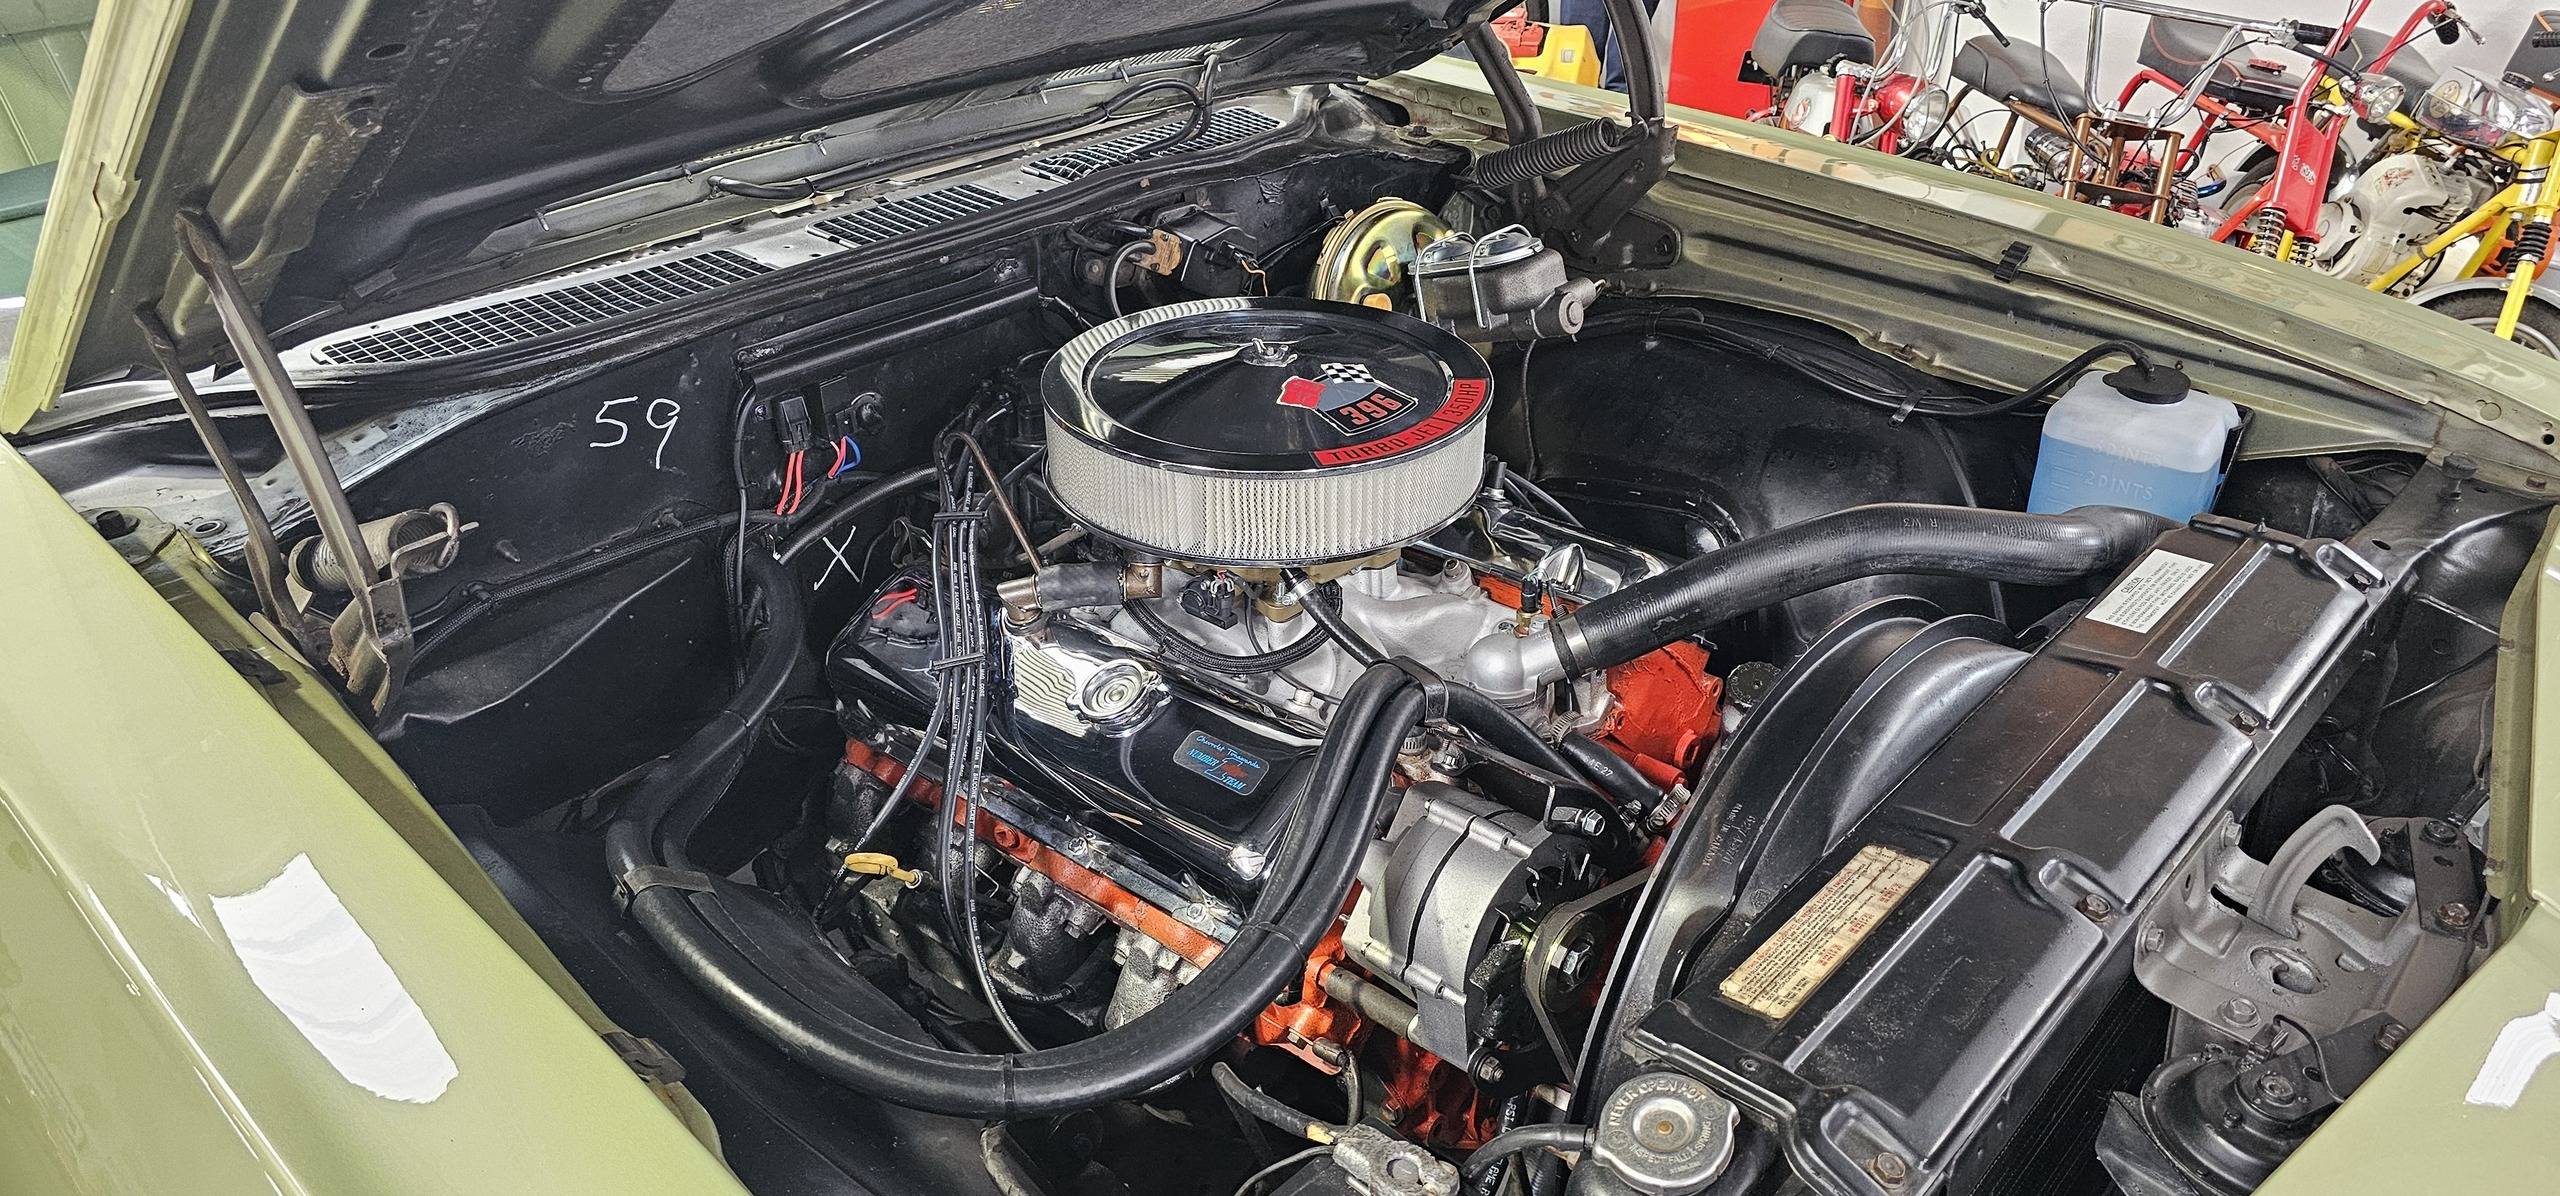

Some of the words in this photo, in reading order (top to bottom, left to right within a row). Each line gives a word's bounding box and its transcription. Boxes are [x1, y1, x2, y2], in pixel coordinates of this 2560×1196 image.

[1339, 393, 1402, 426] 396
[590, 396, 680, 469] 59
[1328, 422, 1443, 463] TURBO-JET
[1187, 748, 1220, 767] NUMBER
[1196, 735, 1225, 752] Chevrolet
[1227, 748, 1261, 769] Tonawanda
[970, 772, 978, 798] SILICONE
[1601, 766, 1614, 777] 27
[1721, 823, 1731, 833] IN
[1702, 834, 1724, 867] CANADA
[1609, 1089, 1639, 1126] NEVER
[1638, 1079, 1679, 1095] OPEN
[1678, 1082, 1706, 1102] HOT
[1694, 1116, 1713, 1152] SPRING
